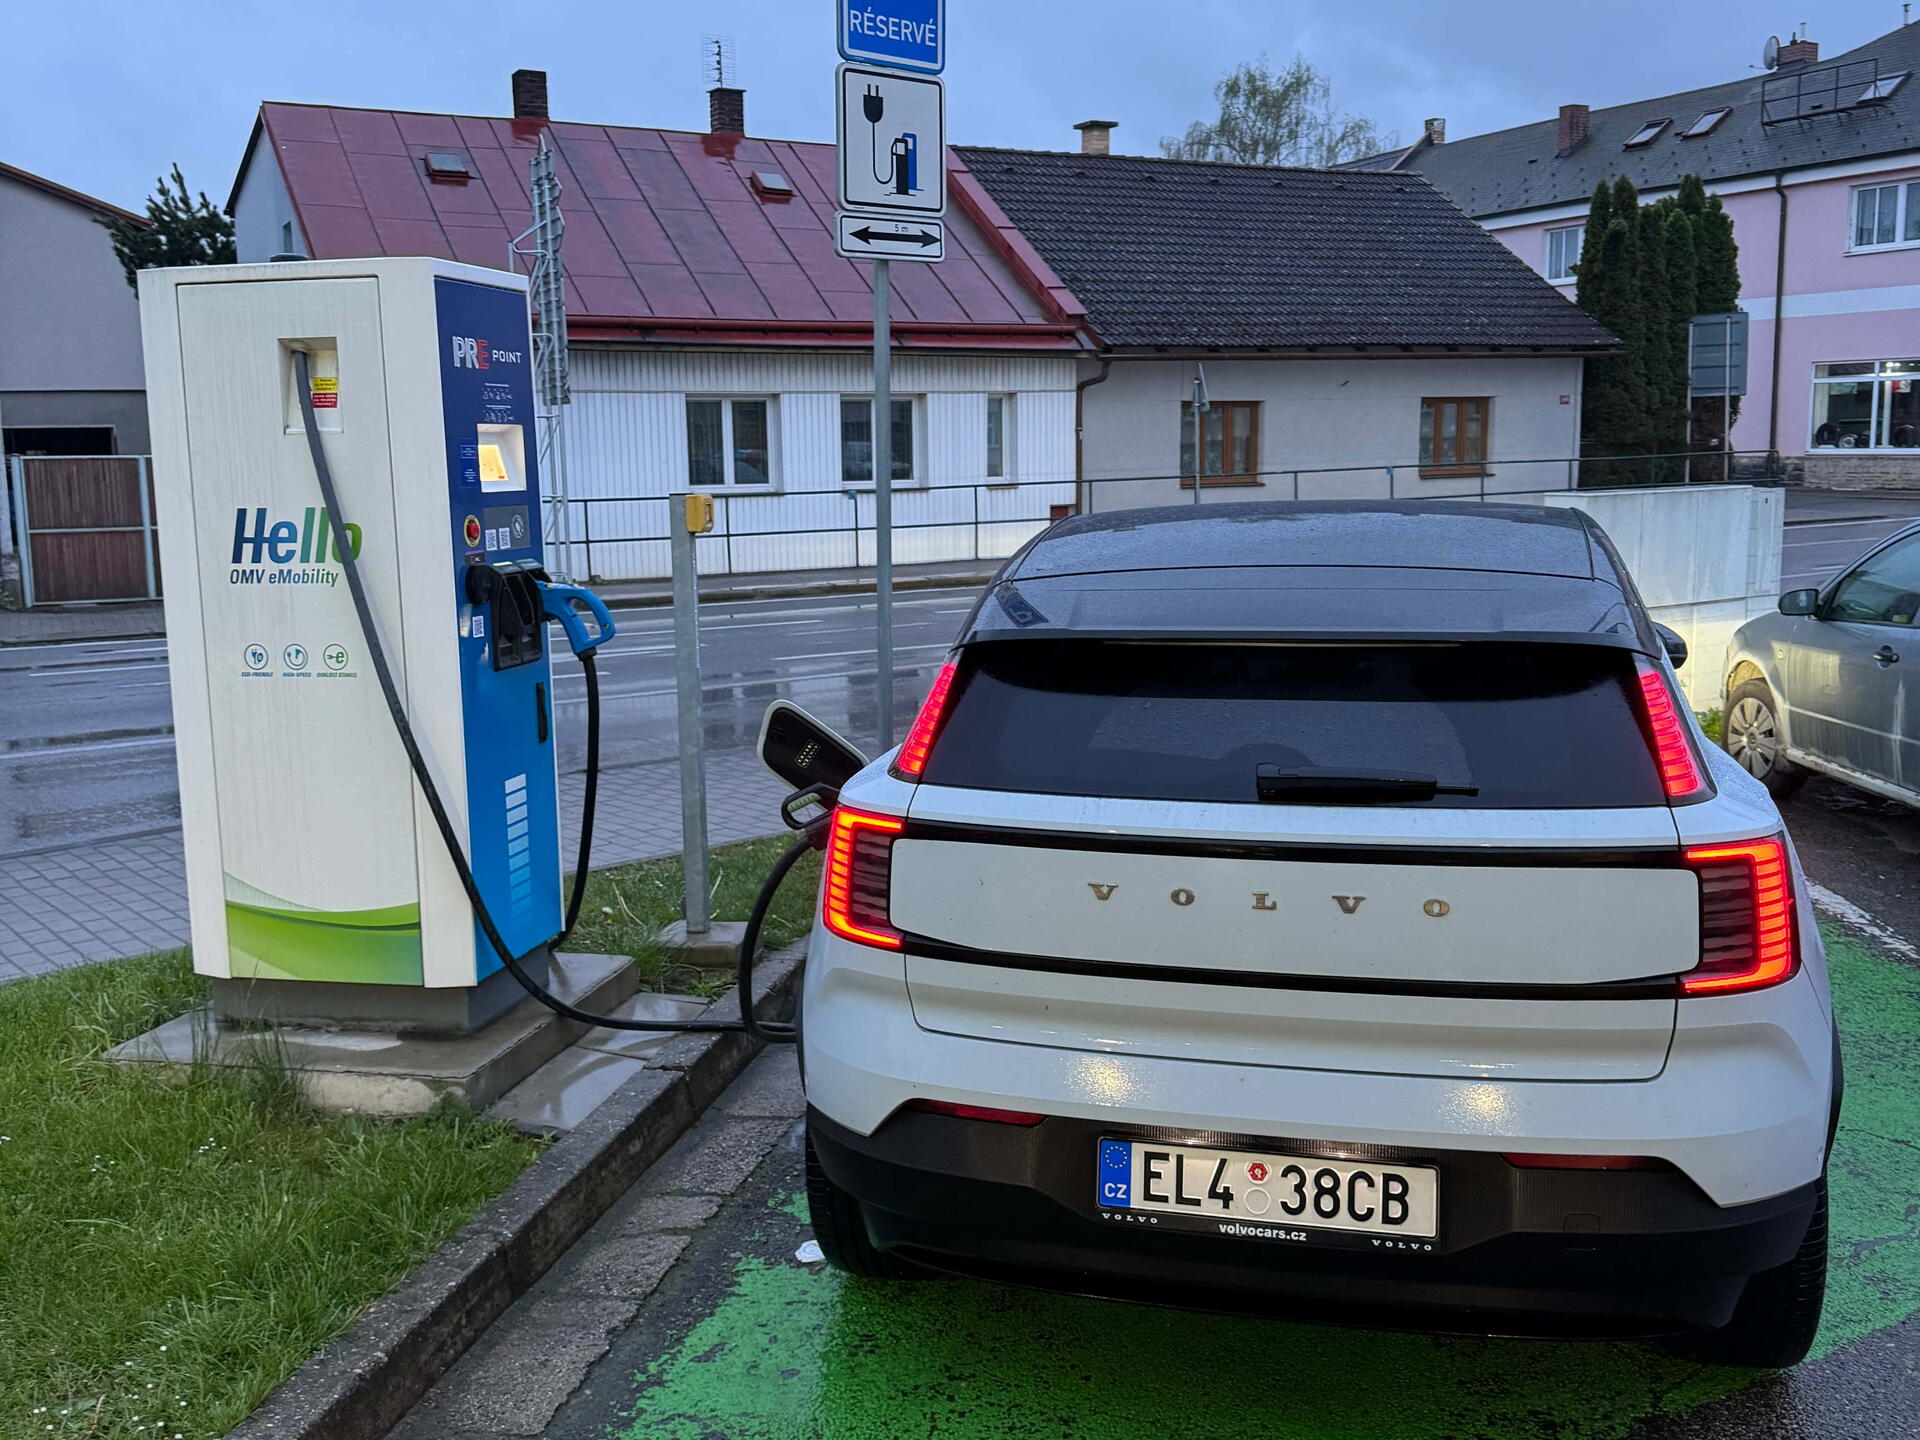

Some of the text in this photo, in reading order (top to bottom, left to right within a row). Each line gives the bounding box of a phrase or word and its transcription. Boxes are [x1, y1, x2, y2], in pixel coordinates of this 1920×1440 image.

[849, 7, 937, 47] RÉSERVÉ
[894, 223, 900, 232] 5
[452, 335, 522, 370] PRE POINT
[231, 506, 362, 564] Hello
[230, 568, 339, 588] OMV eMobility
[1087, 882, 1451, 918] VOLVO
[1104, 1182, 1128, 1200] CZ
[1142, 1150, 1411, 1226] EL4 38CB
[1101, 1212, 1159, 1225] VOLVO
[1218, 1222, 1308, 1242] volvocars.cz
[1371, 1238, 1433, 1252] VOLVO
